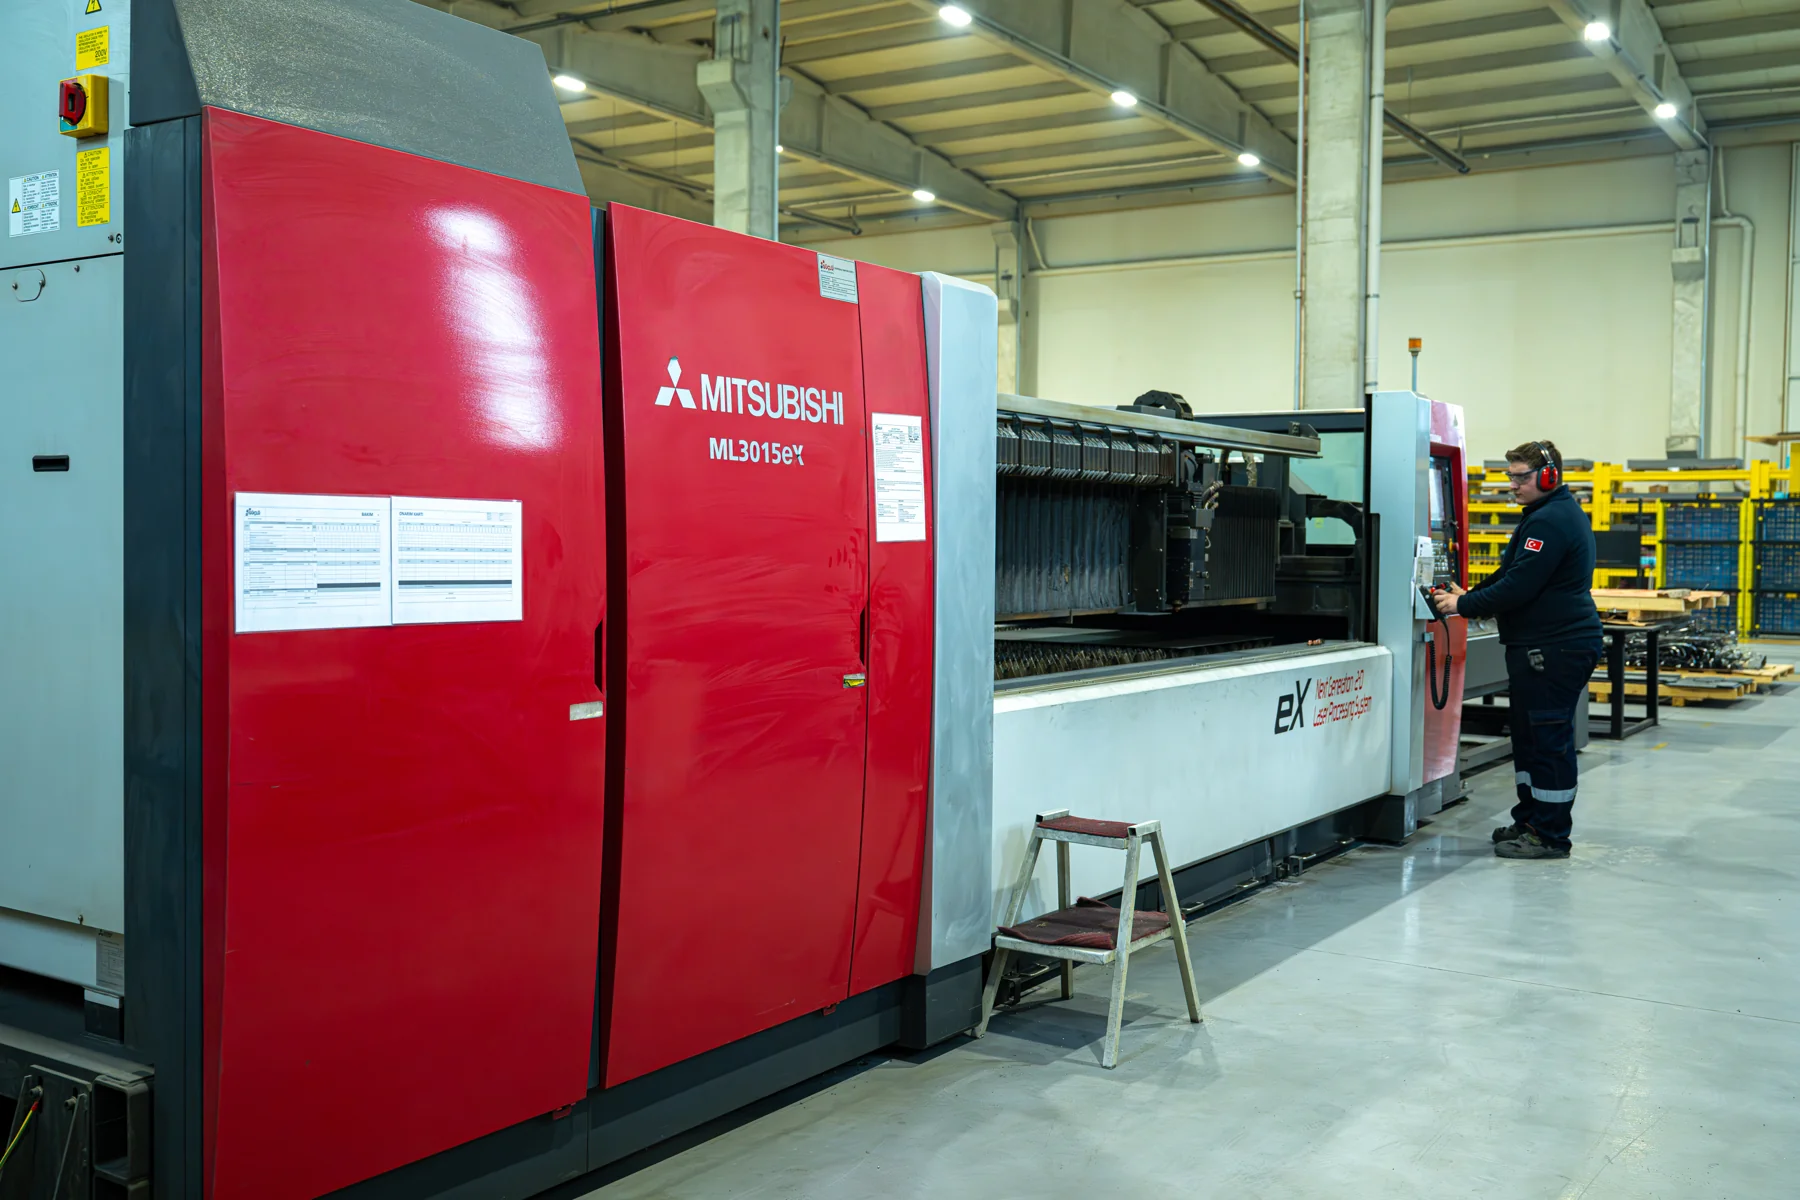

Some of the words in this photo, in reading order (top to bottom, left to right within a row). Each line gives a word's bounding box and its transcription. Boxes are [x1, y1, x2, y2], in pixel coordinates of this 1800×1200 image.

[700, 373, 845, 425] MITSUBISHI
[709, 437, 805, 466] ML3015eX
[1315, 677, 1329, 700] Next
[1328, 672, 1354, 697] Generation
[1274, 677, 1313, 735] eX
[1312, 704, 1329, 727] Laser
[1329, 700, 1355, 723] Processing
[1354, 694, 1372, 719] System
